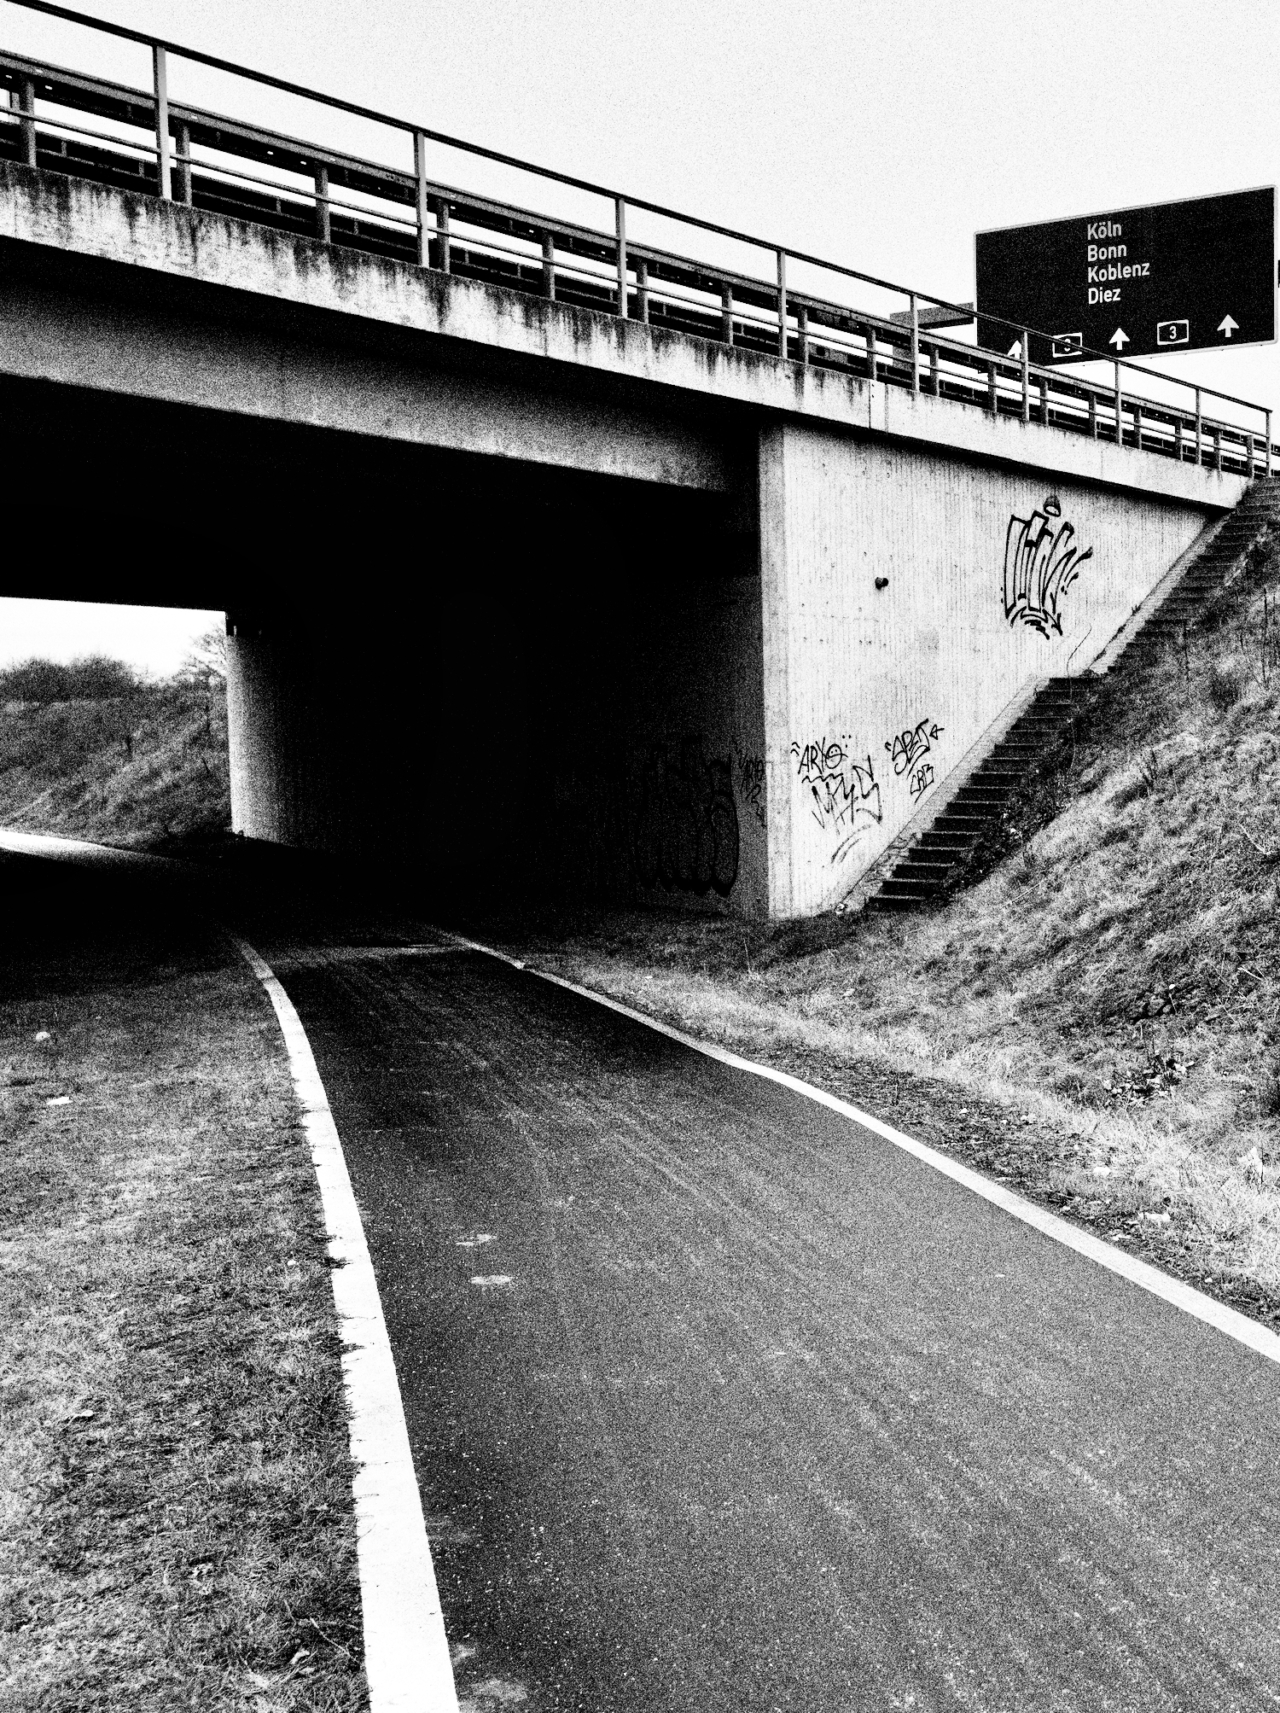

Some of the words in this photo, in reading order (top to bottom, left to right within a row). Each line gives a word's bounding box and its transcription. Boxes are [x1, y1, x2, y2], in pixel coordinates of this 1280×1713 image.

[1087, 220, 1122, 240] Köln
[1087, 244, 1127, 262] Bonn
[1087, 262, 1150, 283] Koblenz
[1088, 286, 1121, 305] Diez
[1169, 325, 1177, 340] 3
